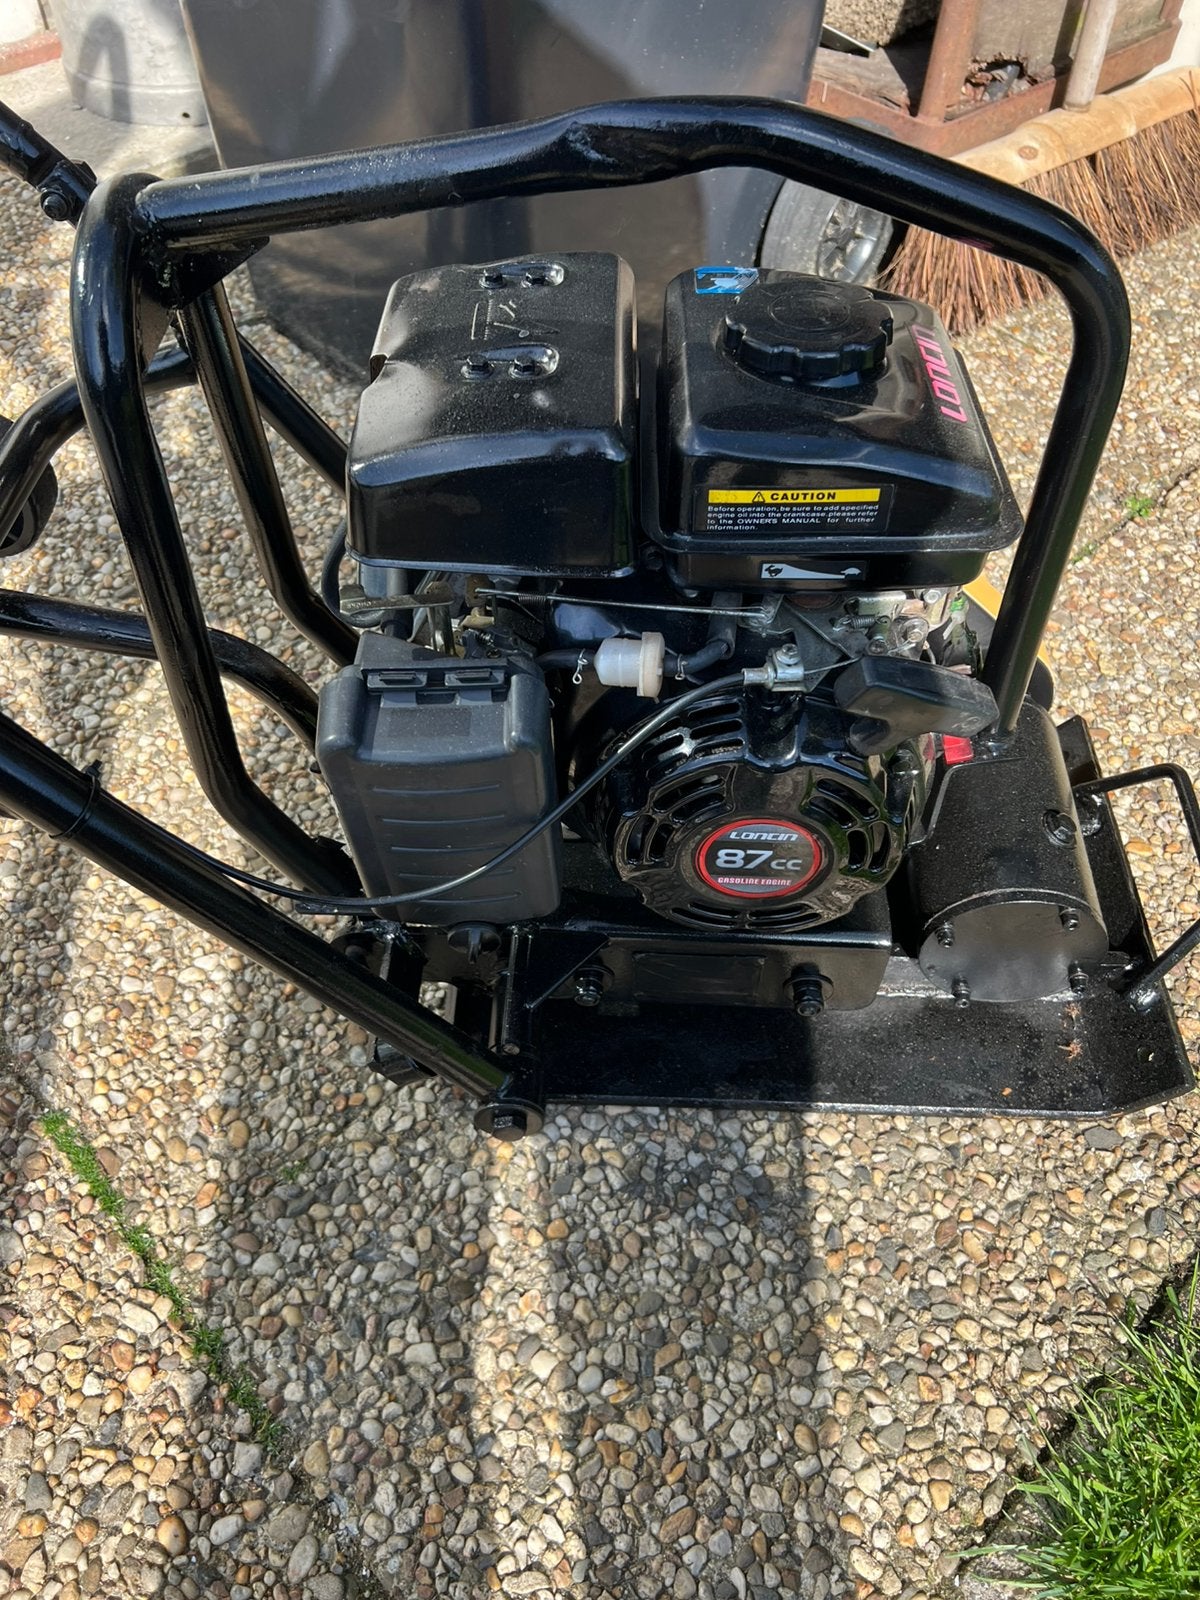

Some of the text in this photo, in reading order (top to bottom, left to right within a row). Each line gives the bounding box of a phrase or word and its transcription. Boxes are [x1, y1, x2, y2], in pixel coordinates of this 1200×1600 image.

[912, 324, 968, 423] LONCIN
[770, 492, 836, 501] CAUTION
[729, 831, 798, 841] LONCIN
[717, 877, 759, 885] GASOLINE
